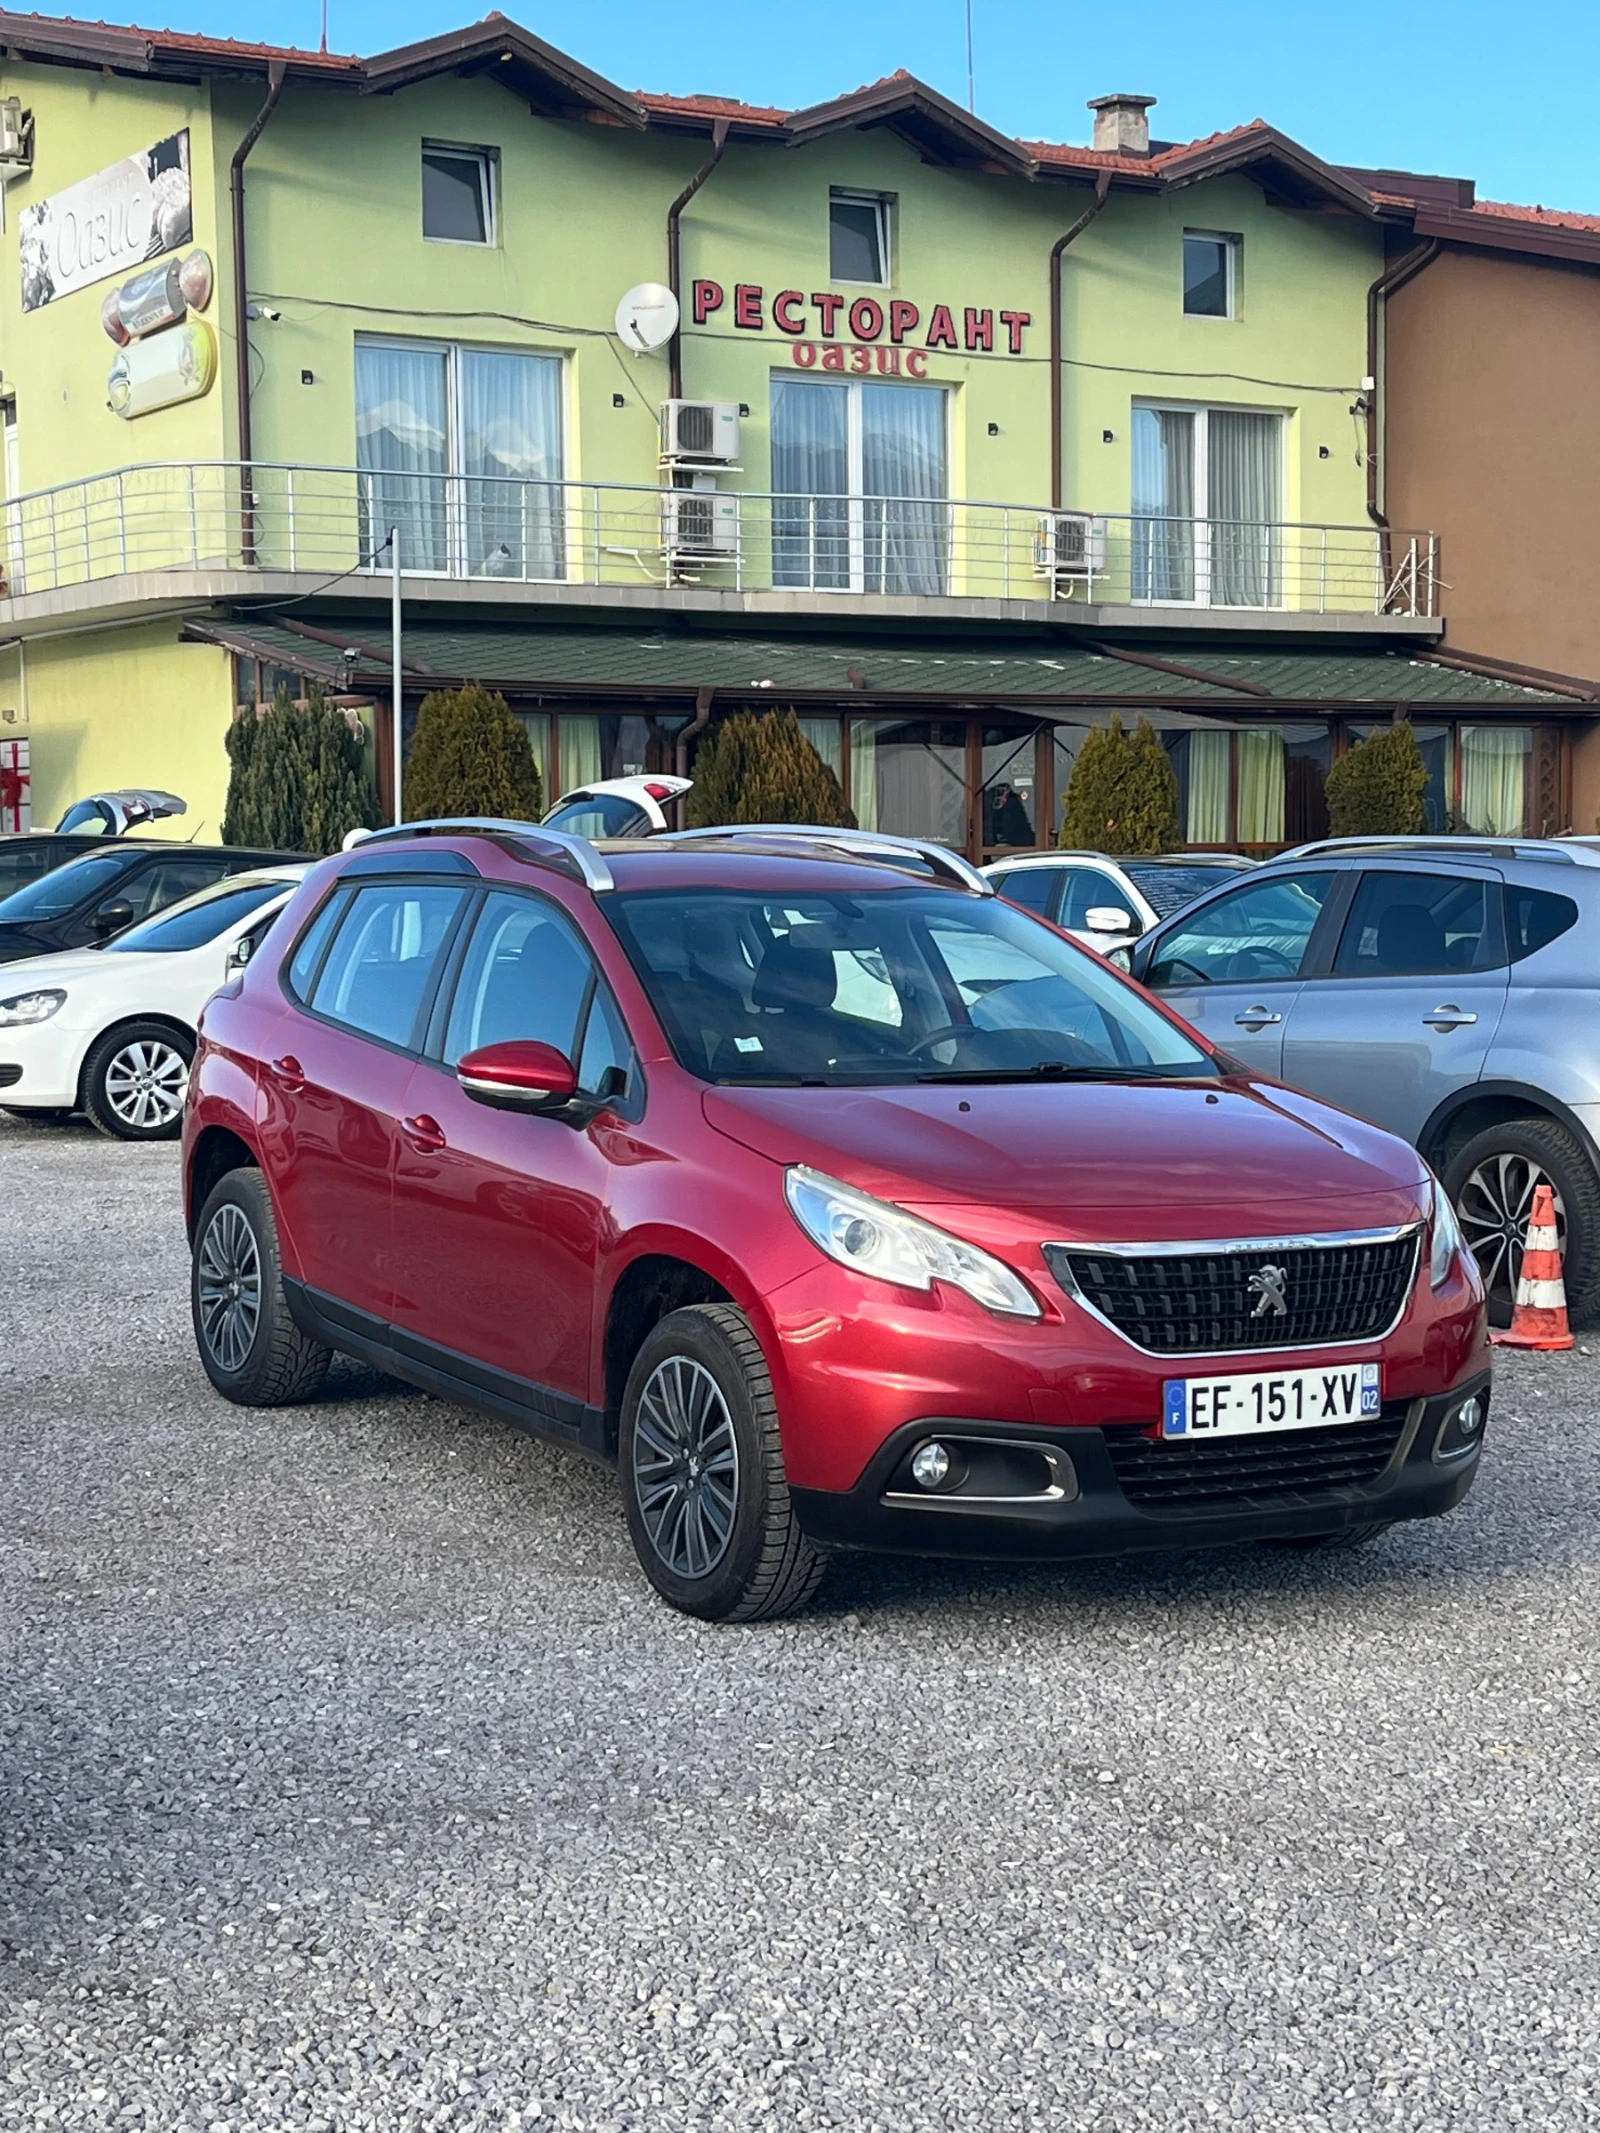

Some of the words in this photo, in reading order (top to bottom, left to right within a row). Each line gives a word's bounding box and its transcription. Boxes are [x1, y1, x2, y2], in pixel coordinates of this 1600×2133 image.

[692, 279, 1031, 354] РЕСТОРАНТ
[792, 341, 929, 378] оазис
[1172, 1412, 1180, 1424] F
[1191, 1373, 1357, 1430] EF-151-XV
[1362, 1390, 1378, 1410] 02
